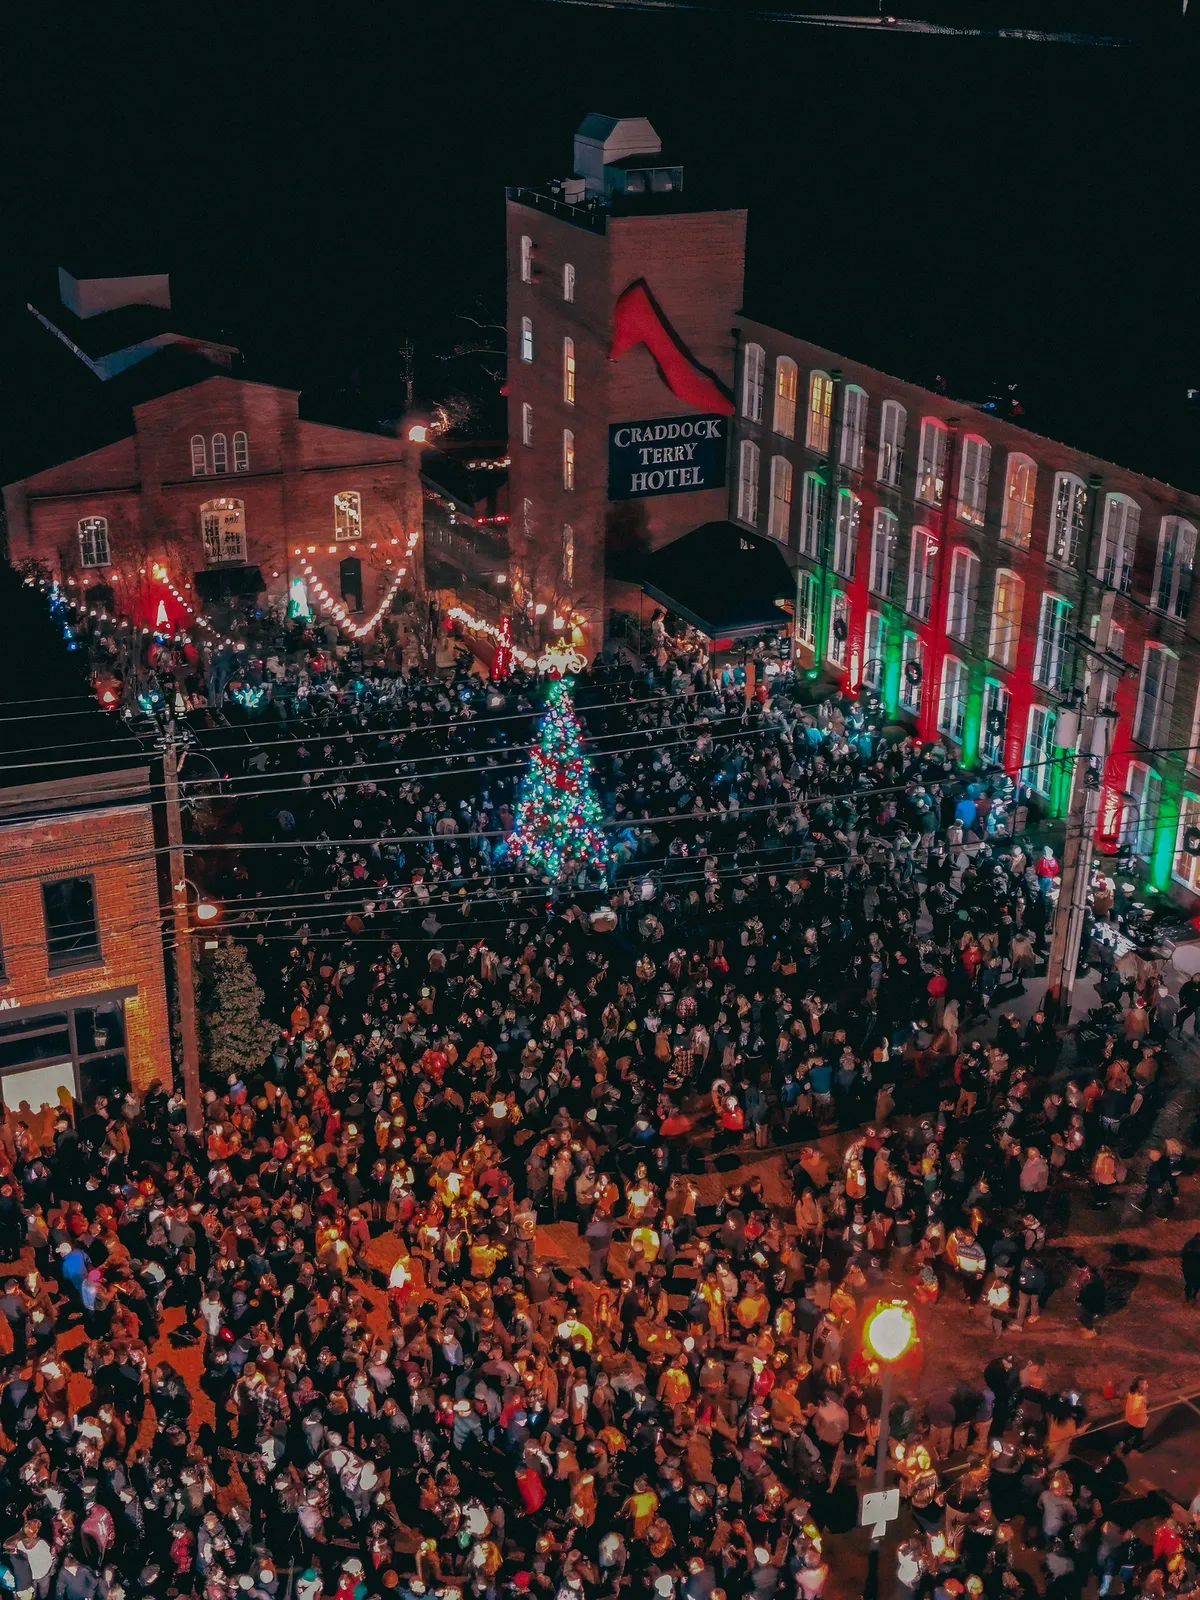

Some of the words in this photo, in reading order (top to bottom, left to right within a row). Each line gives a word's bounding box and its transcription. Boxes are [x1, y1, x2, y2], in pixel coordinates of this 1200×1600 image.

[614, 419, 722, 448] CRADDOCK
[639, 442, 698, 466] TERRY
[630, 466, 704, 492] HOTEL
